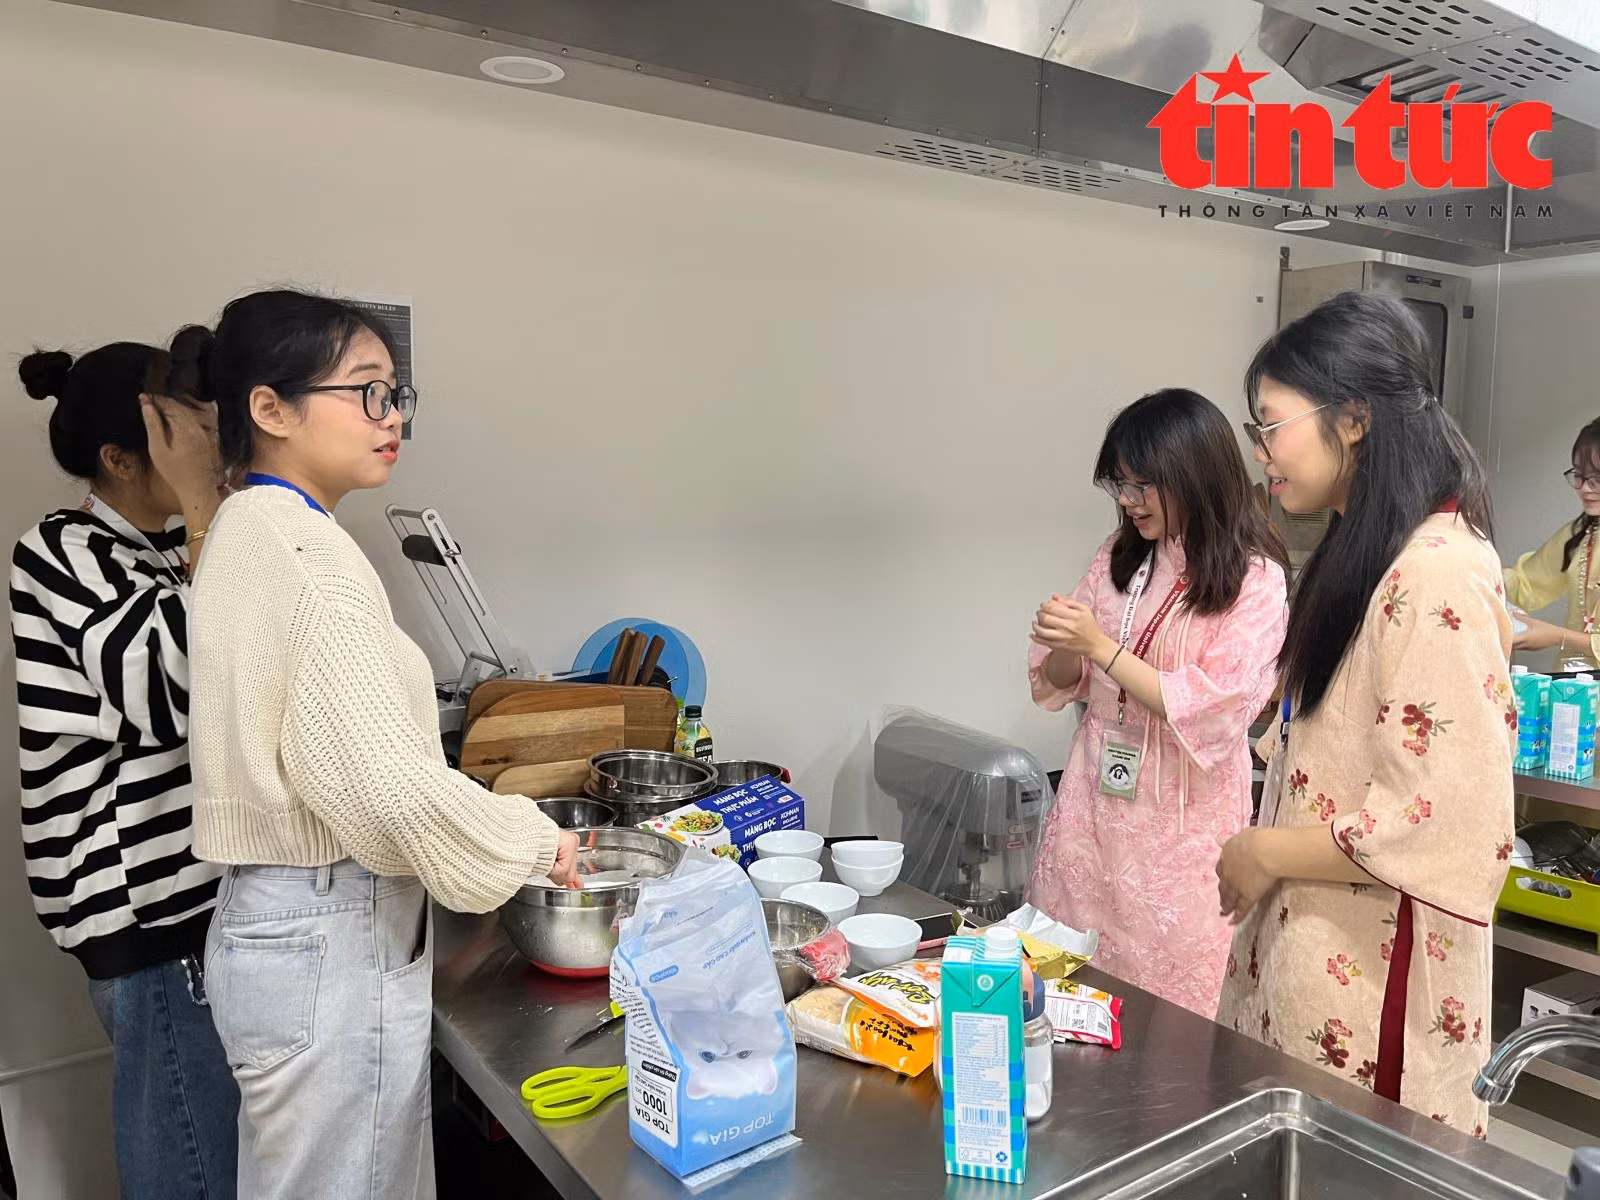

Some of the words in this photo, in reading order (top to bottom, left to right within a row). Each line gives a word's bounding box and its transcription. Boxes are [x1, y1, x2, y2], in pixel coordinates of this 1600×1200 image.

[1160, 590, 1180, 614] Vietnam
[1149, 613, 1163, 631] Japan
[1136, 632, 1152, 658] Universi
[713, 794, 735, 806] MÀNG
[732, 788, 749, 798] BỌC
[780, 807, 800, 820] KOHNAN
[744, 823, 764, 838] MÀNG
[763, 817, 777, 830] BỌC
[643, 1090, 668, 1116] 1000
[634, 1105, 651, 1122] GIA
[743, 1111, 774, 1134] TOP
[652, 1118, 671, 1135] TOP
[709, 1126, 740, 1146] GIA
